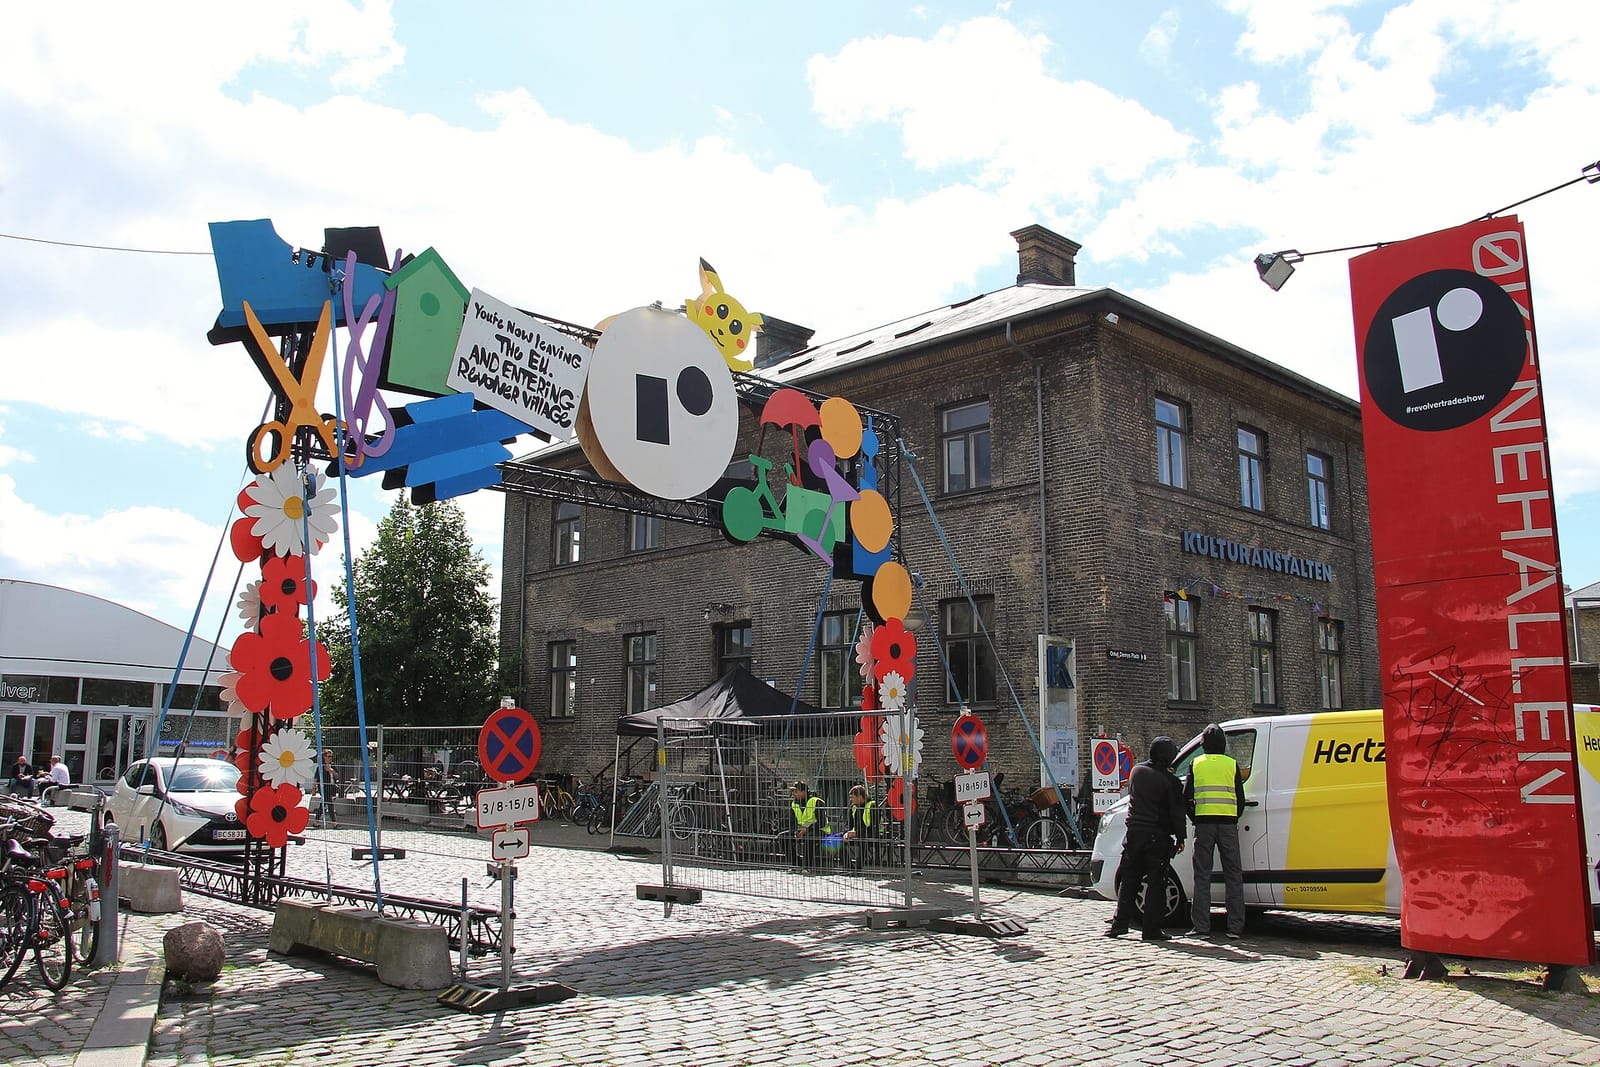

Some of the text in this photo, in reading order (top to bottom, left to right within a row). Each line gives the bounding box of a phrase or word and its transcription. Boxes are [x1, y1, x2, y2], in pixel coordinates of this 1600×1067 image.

[506, 321, 533, 342] Now
[469, 344, 499, 373] AND
[1406, 394, 1485, 414] #revolvertradeshow
[1182, 530, 1334, 583] KULTURANSTALTEN
[1046, 644, 1075, 689] K
[1313, 738, 1386, 764] Hertz
[1098, 778, 1114, 787] Zone
[482, 796, 535, 815] 3/8-15/8
